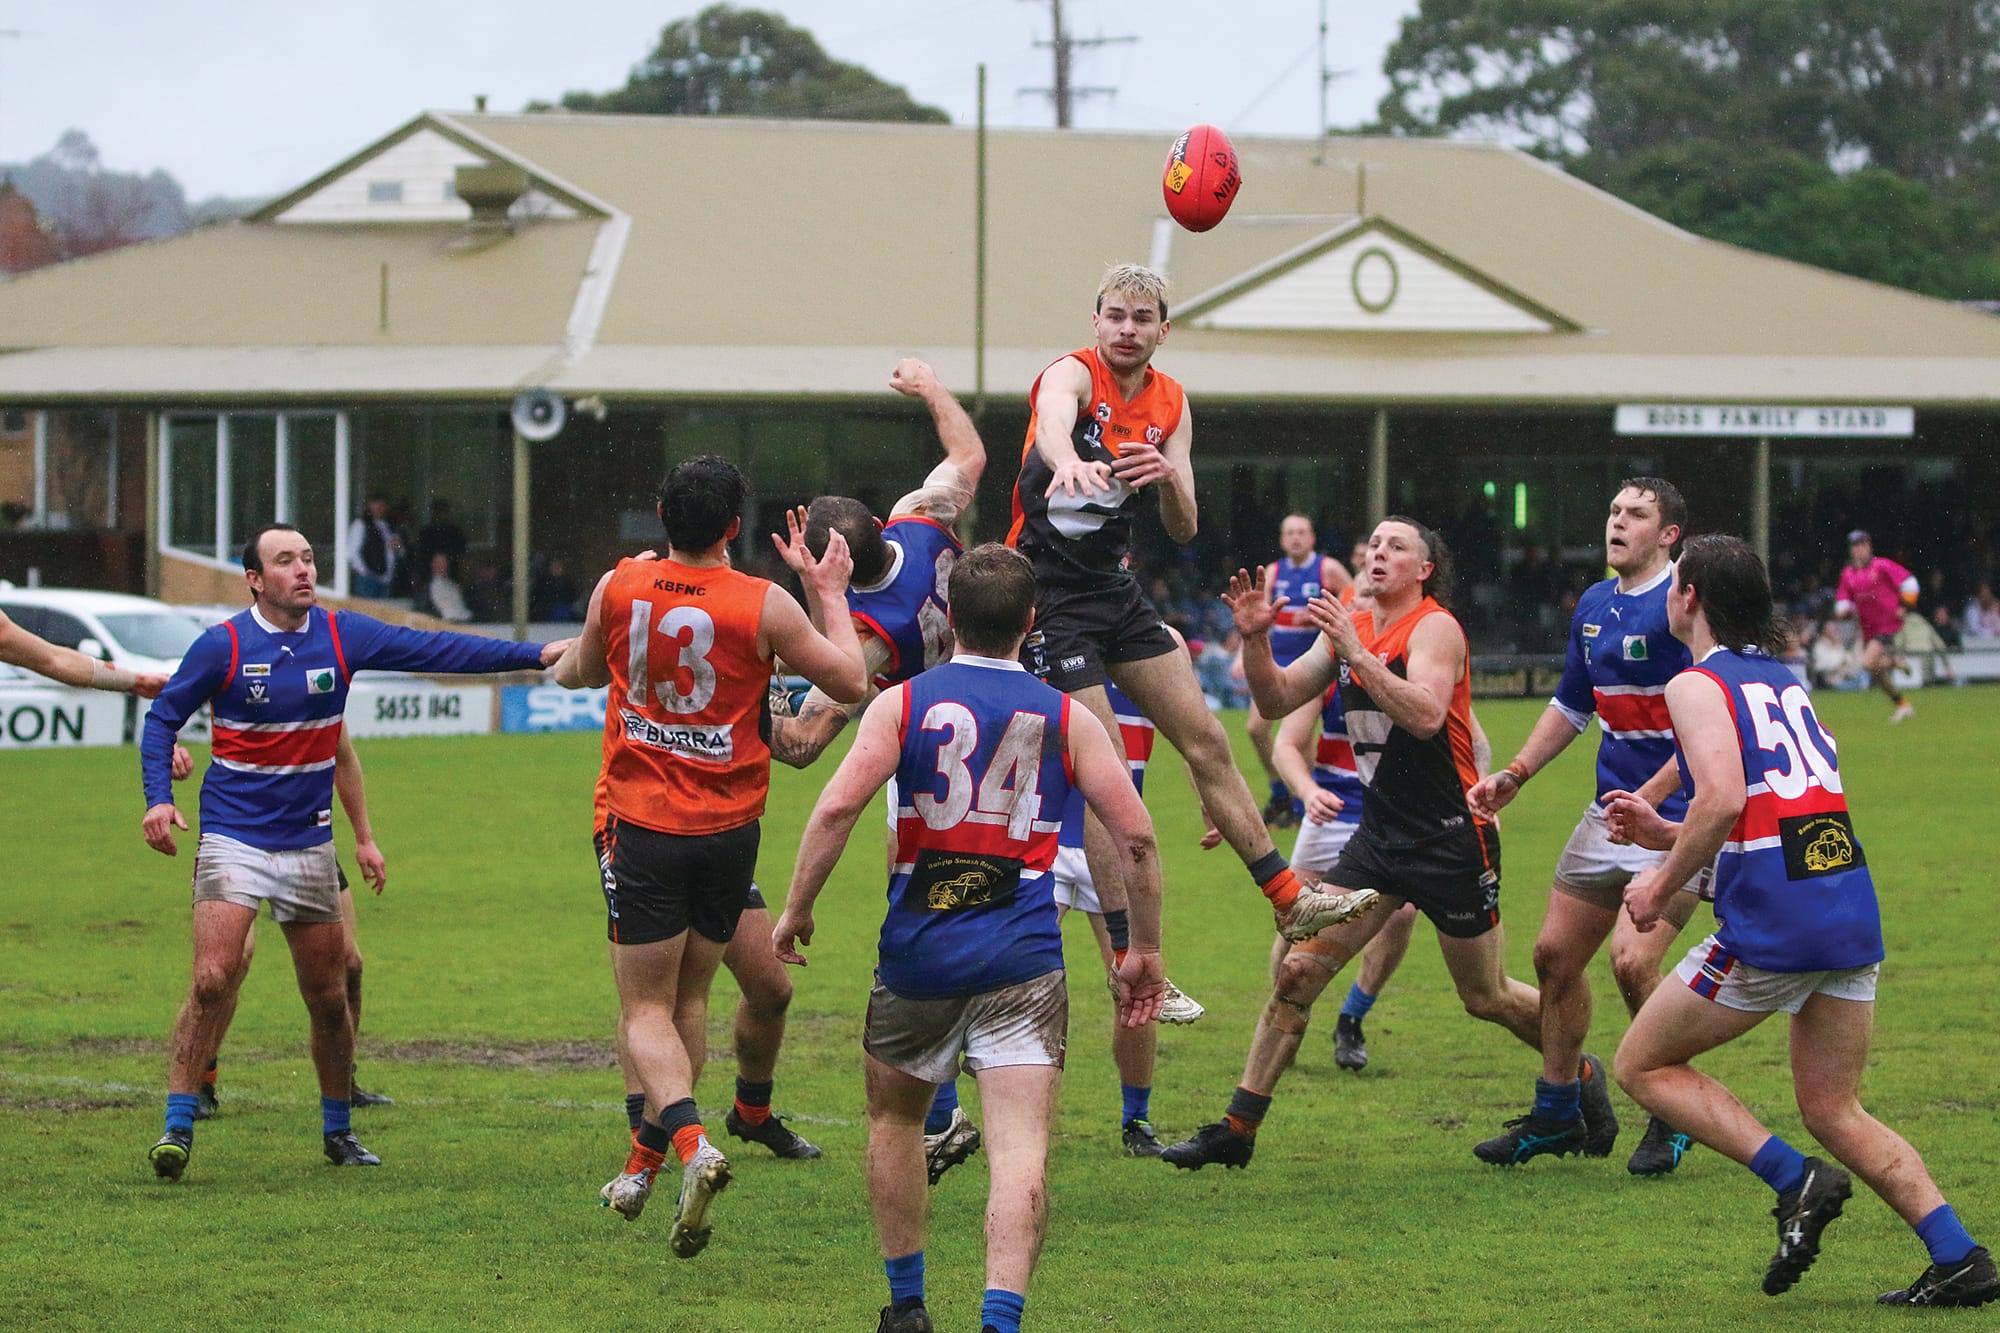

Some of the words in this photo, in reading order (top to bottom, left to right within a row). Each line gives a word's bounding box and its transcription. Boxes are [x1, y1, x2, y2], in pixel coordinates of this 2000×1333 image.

[1720, 408, 1798, 426] FAMILY
[653, 579, 707, 597] KBFNC
[627, 598, 717, 714] 13
[375, 696, 421, 720] 5655
[428, 695, 461, 719] 1142
[0, 705, 85, 742] ON
[646, 723, 726, 749] BURRA
[1739, 682, 1845, 800] 50
[913, 700, 1047, 842] 34
[954, 857, 979, 866] Smash
